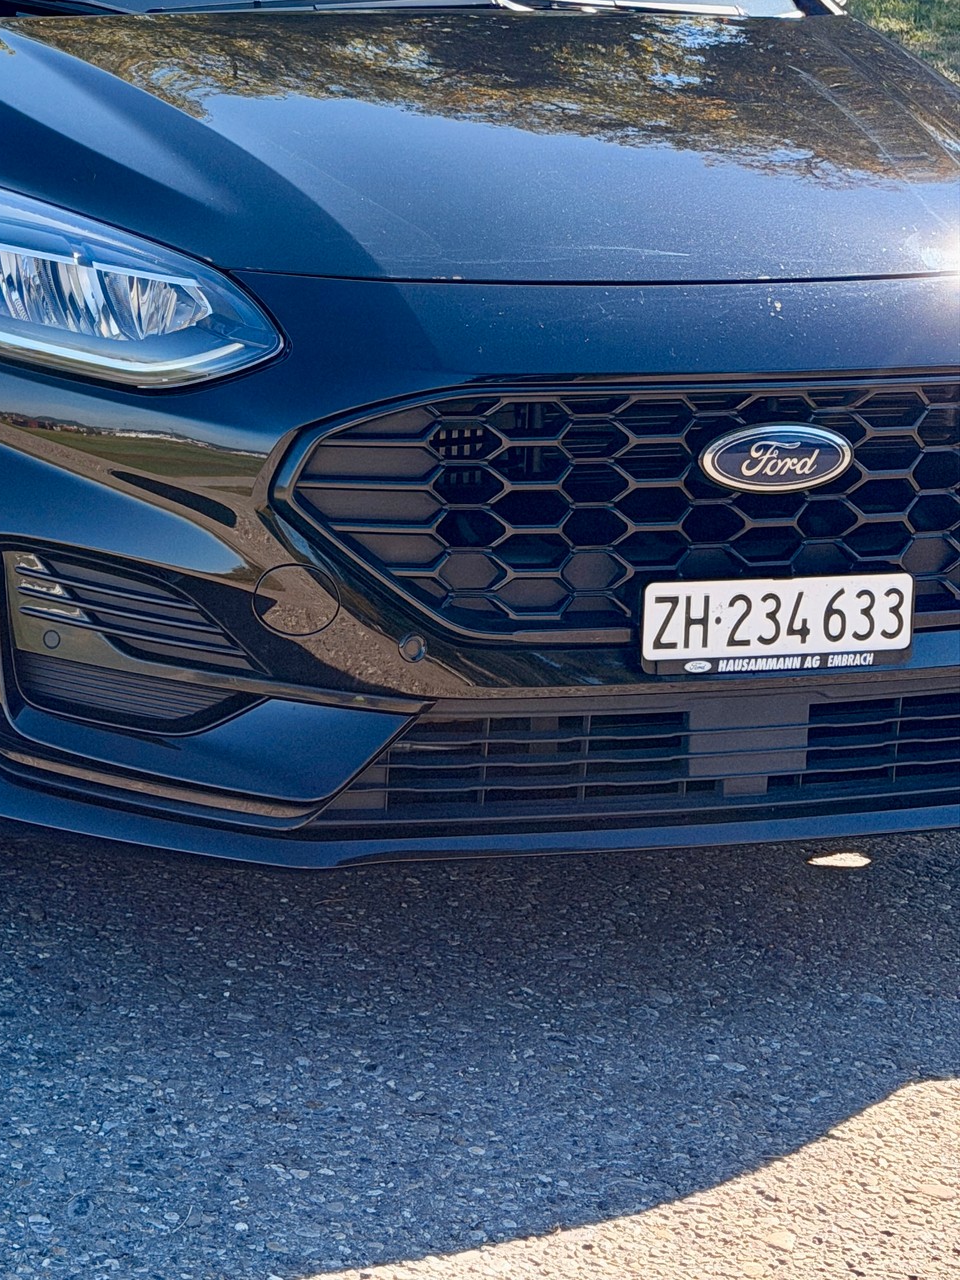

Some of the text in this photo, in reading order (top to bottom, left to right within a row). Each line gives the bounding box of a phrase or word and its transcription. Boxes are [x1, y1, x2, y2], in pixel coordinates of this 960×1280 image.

[740, 440, 820, 477] Ford
[718, 653, 875, 672] HAUSAMMANN AG EMBRACH
